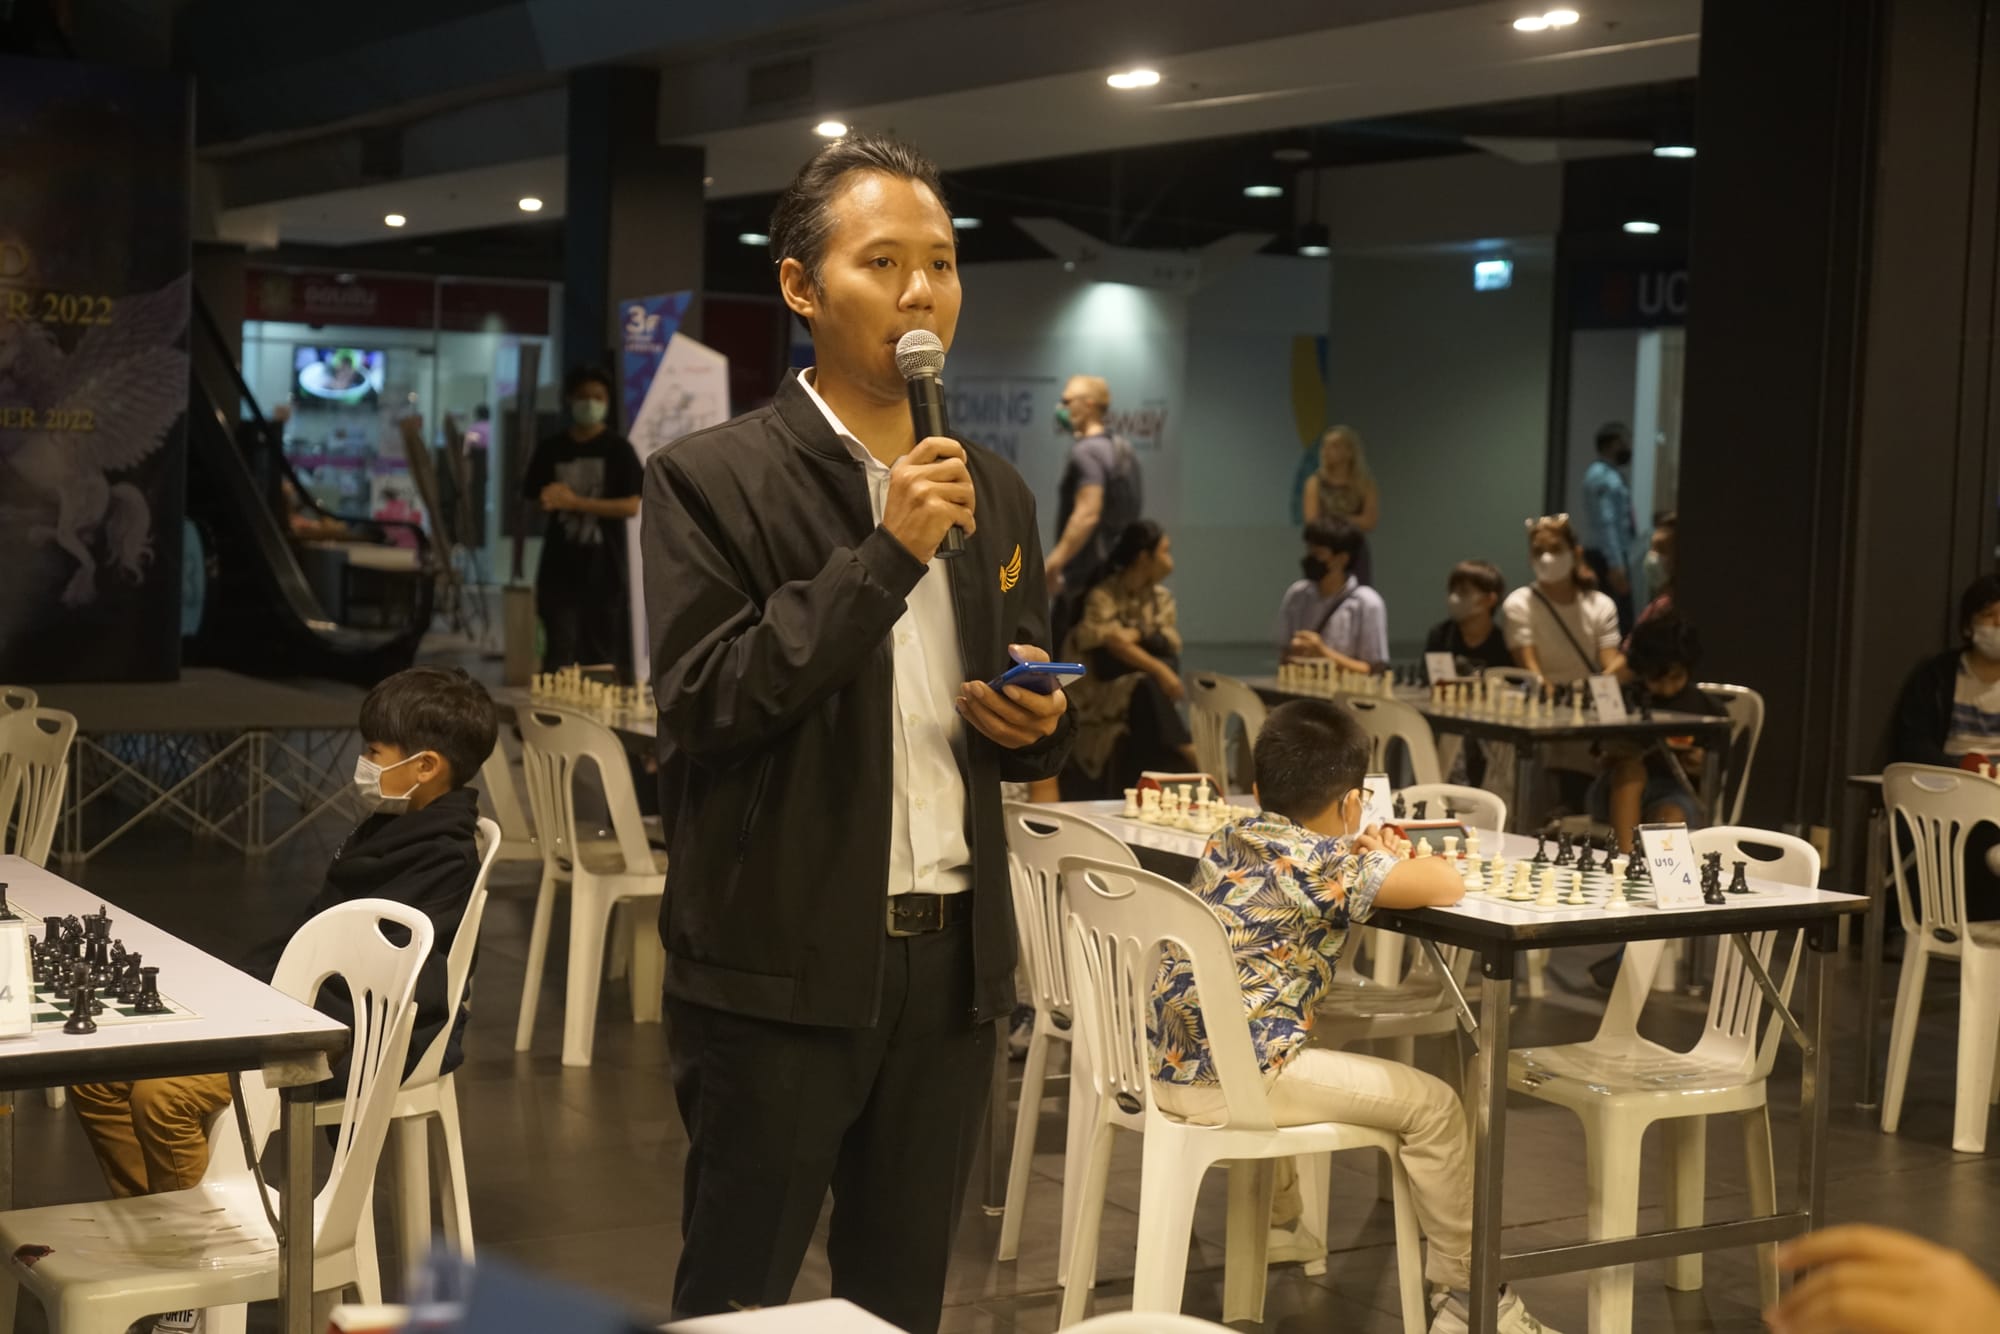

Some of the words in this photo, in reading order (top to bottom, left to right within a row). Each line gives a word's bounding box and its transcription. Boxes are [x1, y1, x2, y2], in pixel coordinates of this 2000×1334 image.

[41, 293, 113, 325] 2022
[0, 407, 36, 429] ER
[44, 408, 96, 432] 2022
[1655, 857, 1674, 868] U10
[1682, 872, 1692, 885] 4
[0, 985, 13, 1003] 4
[161, 1309, 195, 1323] ORTIF
